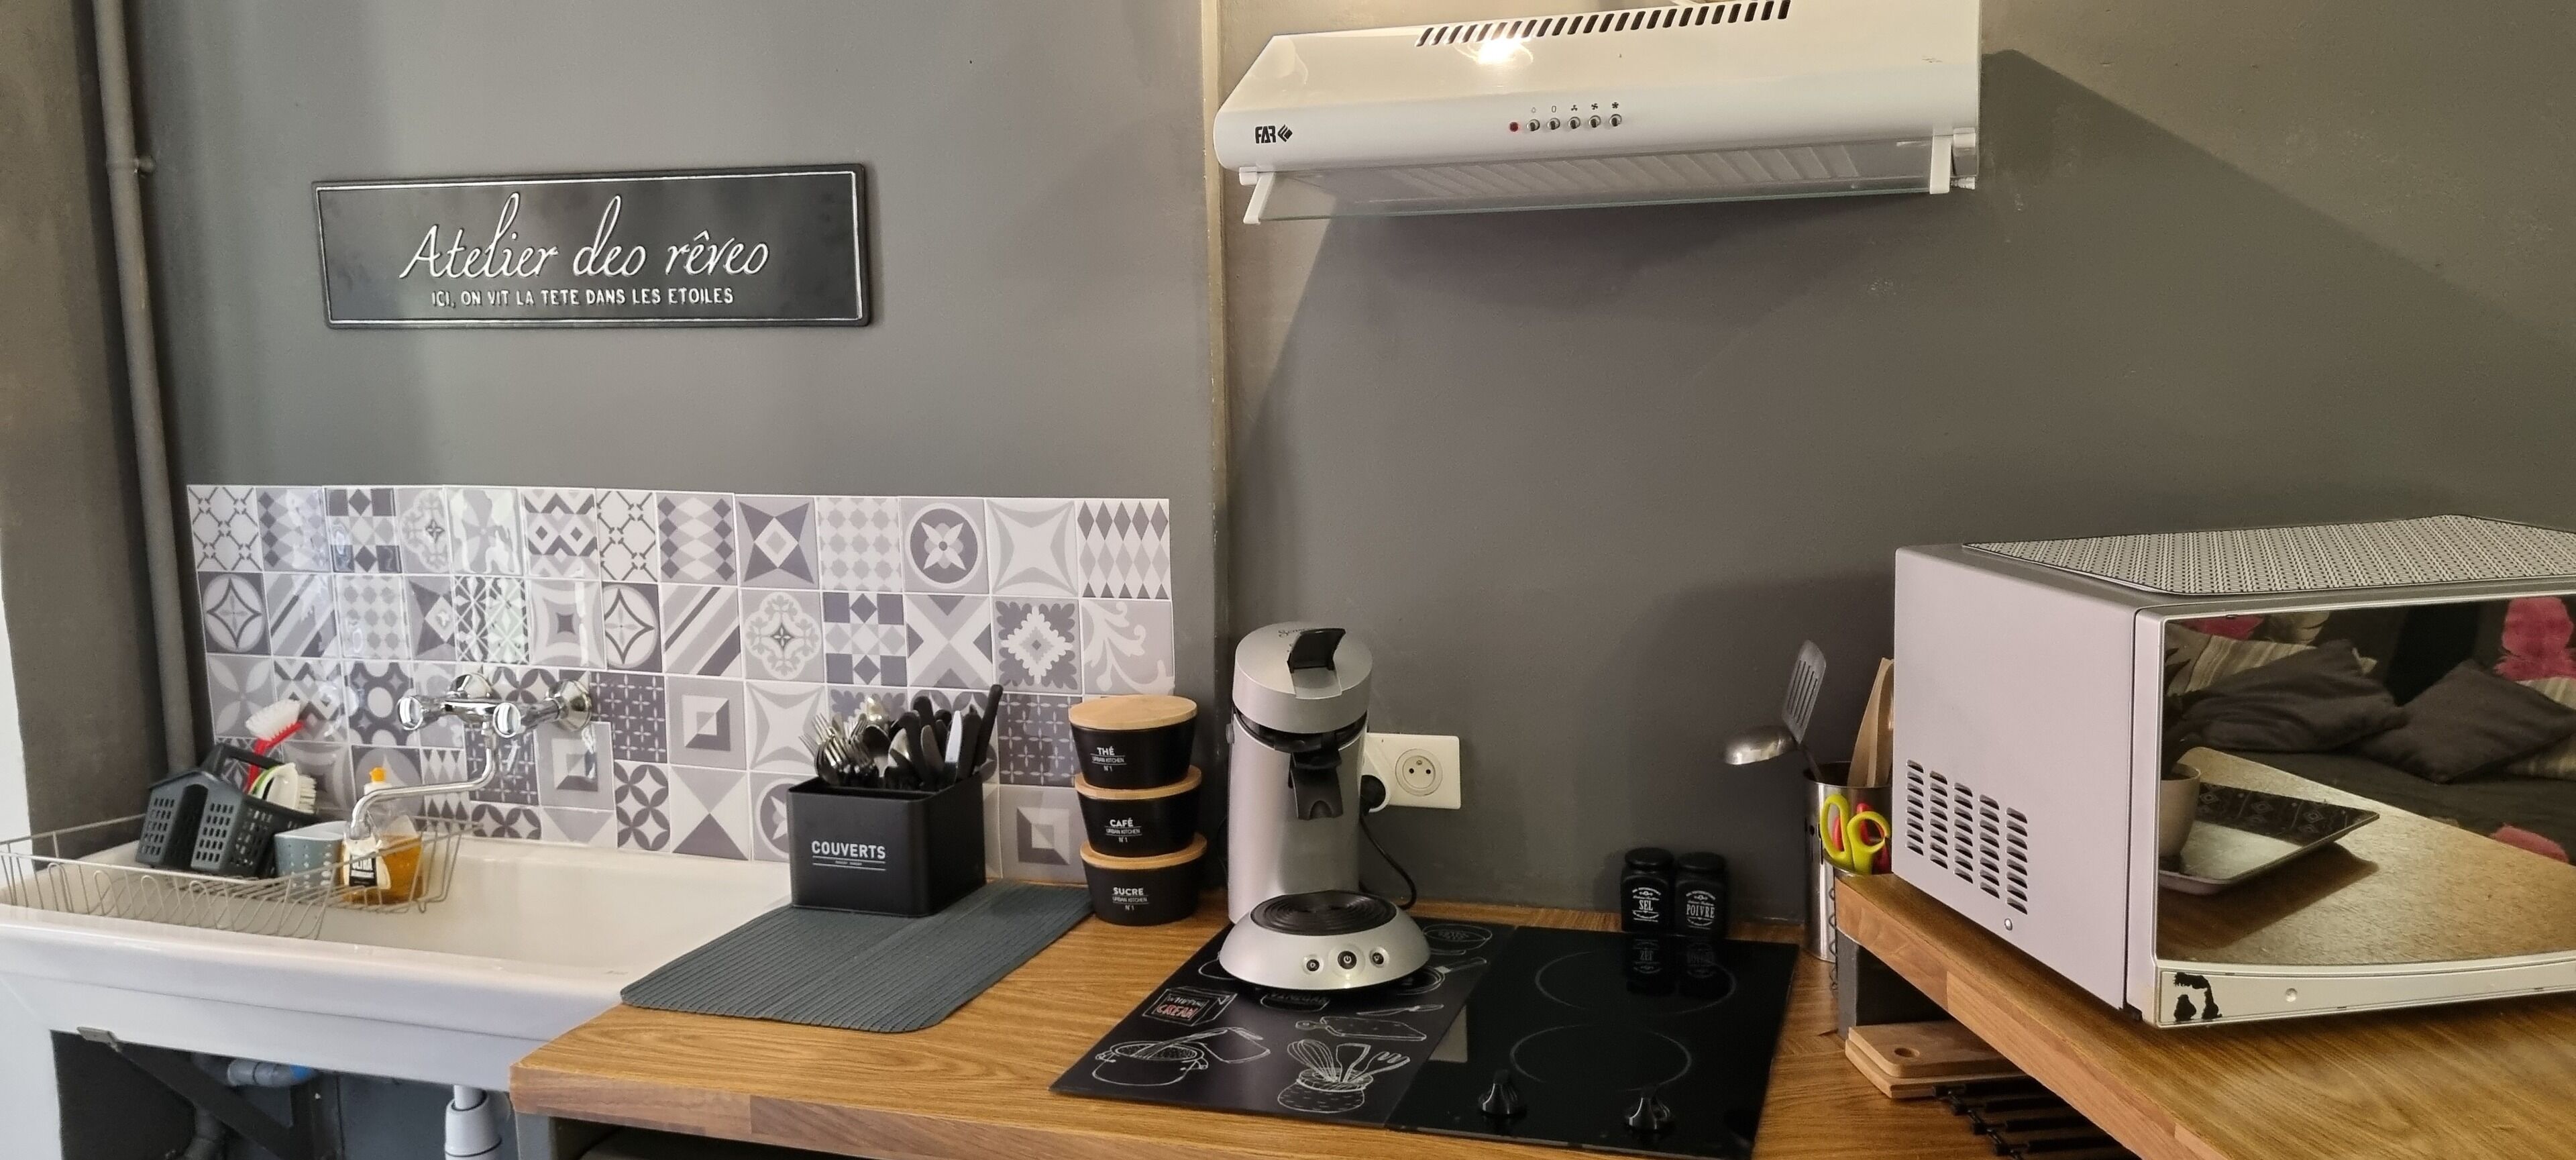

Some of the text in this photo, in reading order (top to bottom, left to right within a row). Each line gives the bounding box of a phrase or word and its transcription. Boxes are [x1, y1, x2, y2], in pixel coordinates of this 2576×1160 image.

[1255, 125, 1276, 144] FAR
[398, 191, 769, 278] Atelier des rêves
[431, 286, 734, 308] ICI, ON VIT LA TETE DANS LES ETOILES
[1096, 745, 1115, 755] THÉ
[1109, 817, 1134, 827] CAFÉ
[811, 840, 886, 859] COUVERTS
[1113, 886, 1144, 896] SUCRE
[1639, 900, 1654, 911] SEL
[1686, 904, 1715, 918] POIVRE
[1157, 1004, 1199, 1018] CREAM
